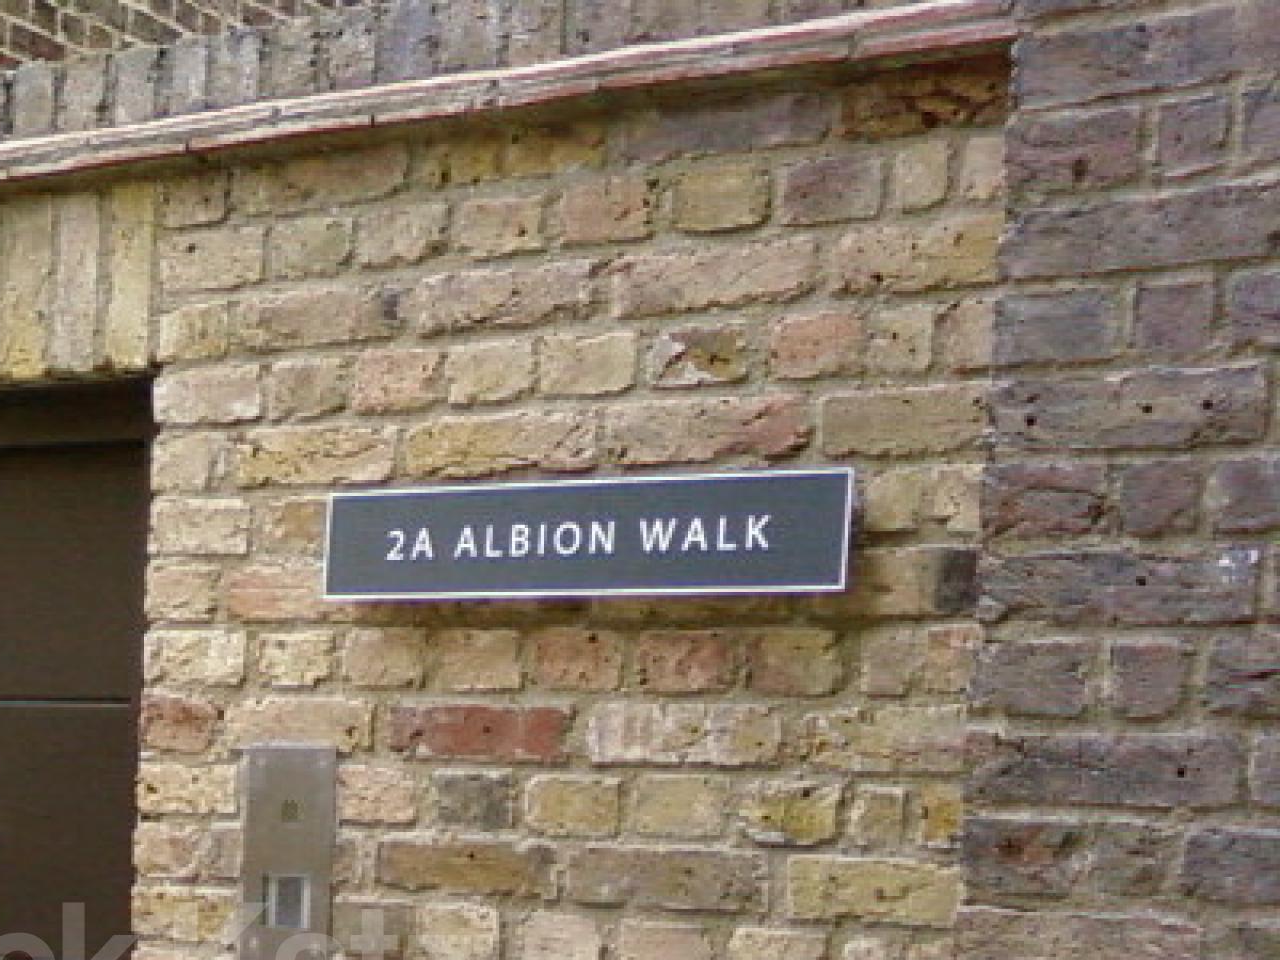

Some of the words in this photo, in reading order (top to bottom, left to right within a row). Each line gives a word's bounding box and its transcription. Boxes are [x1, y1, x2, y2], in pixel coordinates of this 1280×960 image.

[385, 528, 435, 561] 2A
[453, 520, 616, 559] ALBION
[639, 513, 773, 552] WALK
